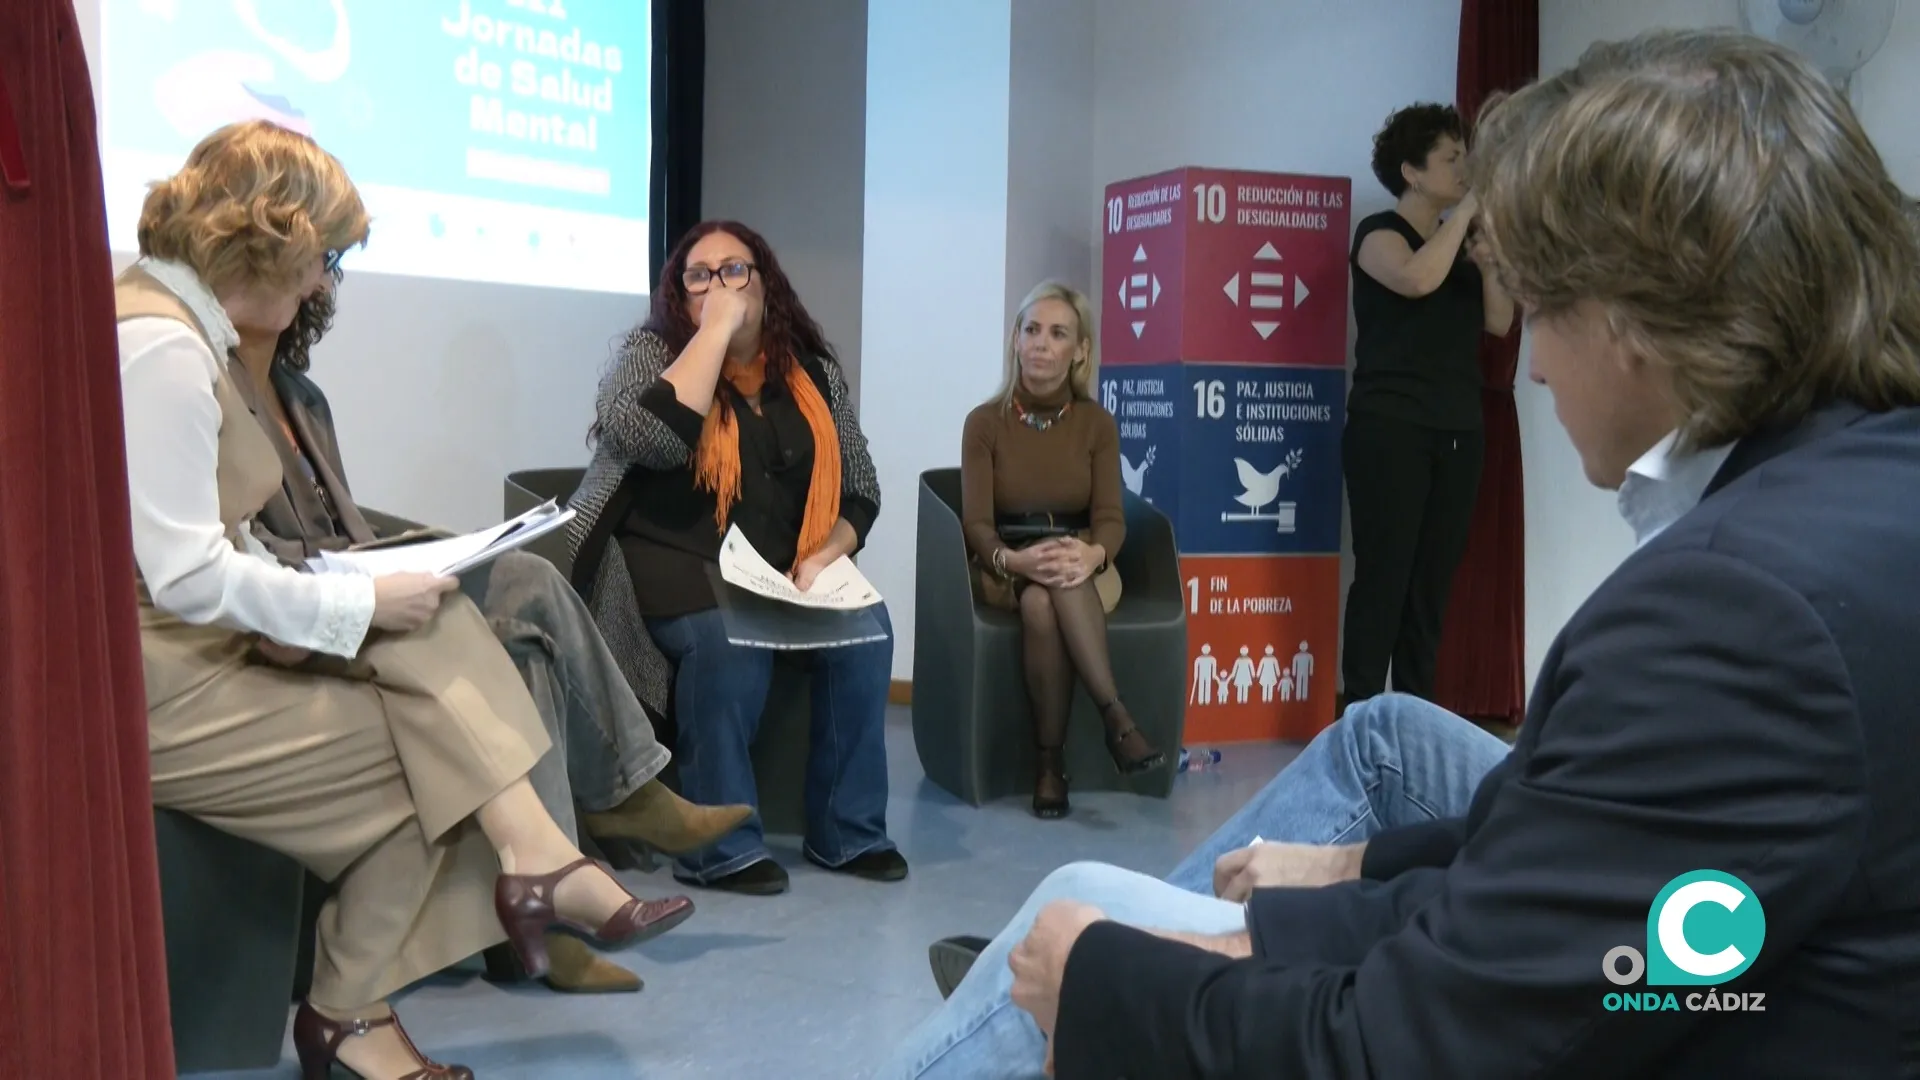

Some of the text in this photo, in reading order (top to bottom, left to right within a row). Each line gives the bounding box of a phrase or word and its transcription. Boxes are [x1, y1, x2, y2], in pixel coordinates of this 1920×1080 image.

[441, 0, 622, 73] Jornadas
[454, 46, 613, 113] de Salud
[470, 93, 597, 152] Mental
[1169, 183, 1181, 201] LAS
[1193, 183, 1226, 223] 10
[1237, 185, 1343, 208] REDUCCIÓN DE LAS
[1107, 195, 1123, 234] 10
[1126, 207, 1172, 232] DESIGUALDADES
[1237, 209, 1327, 229] DESIGUALDADES
[1102, 379, 1118, 416] 16
[1122, 379, 1164, 396] PAZ, JUSTICIA
[1236, 381, 1314, 399] PAZ, JUSTICIA
[1121, 401, 1174, 418] E INSTITUCIONES
[1193, 380, 1225, 419] 16
[1236, 404, 1331, 421] E INSTITUCIONES
[1120, 419, 1146, 439] SÓLIDAS
[1236, 421, 1284, 443] SÓLIDAS
[1187, 576, 1199, 614] 1
[1210, 576, 1228, 592] FIN
[1210, 597, 1292, 614] DE LA POBREZA
